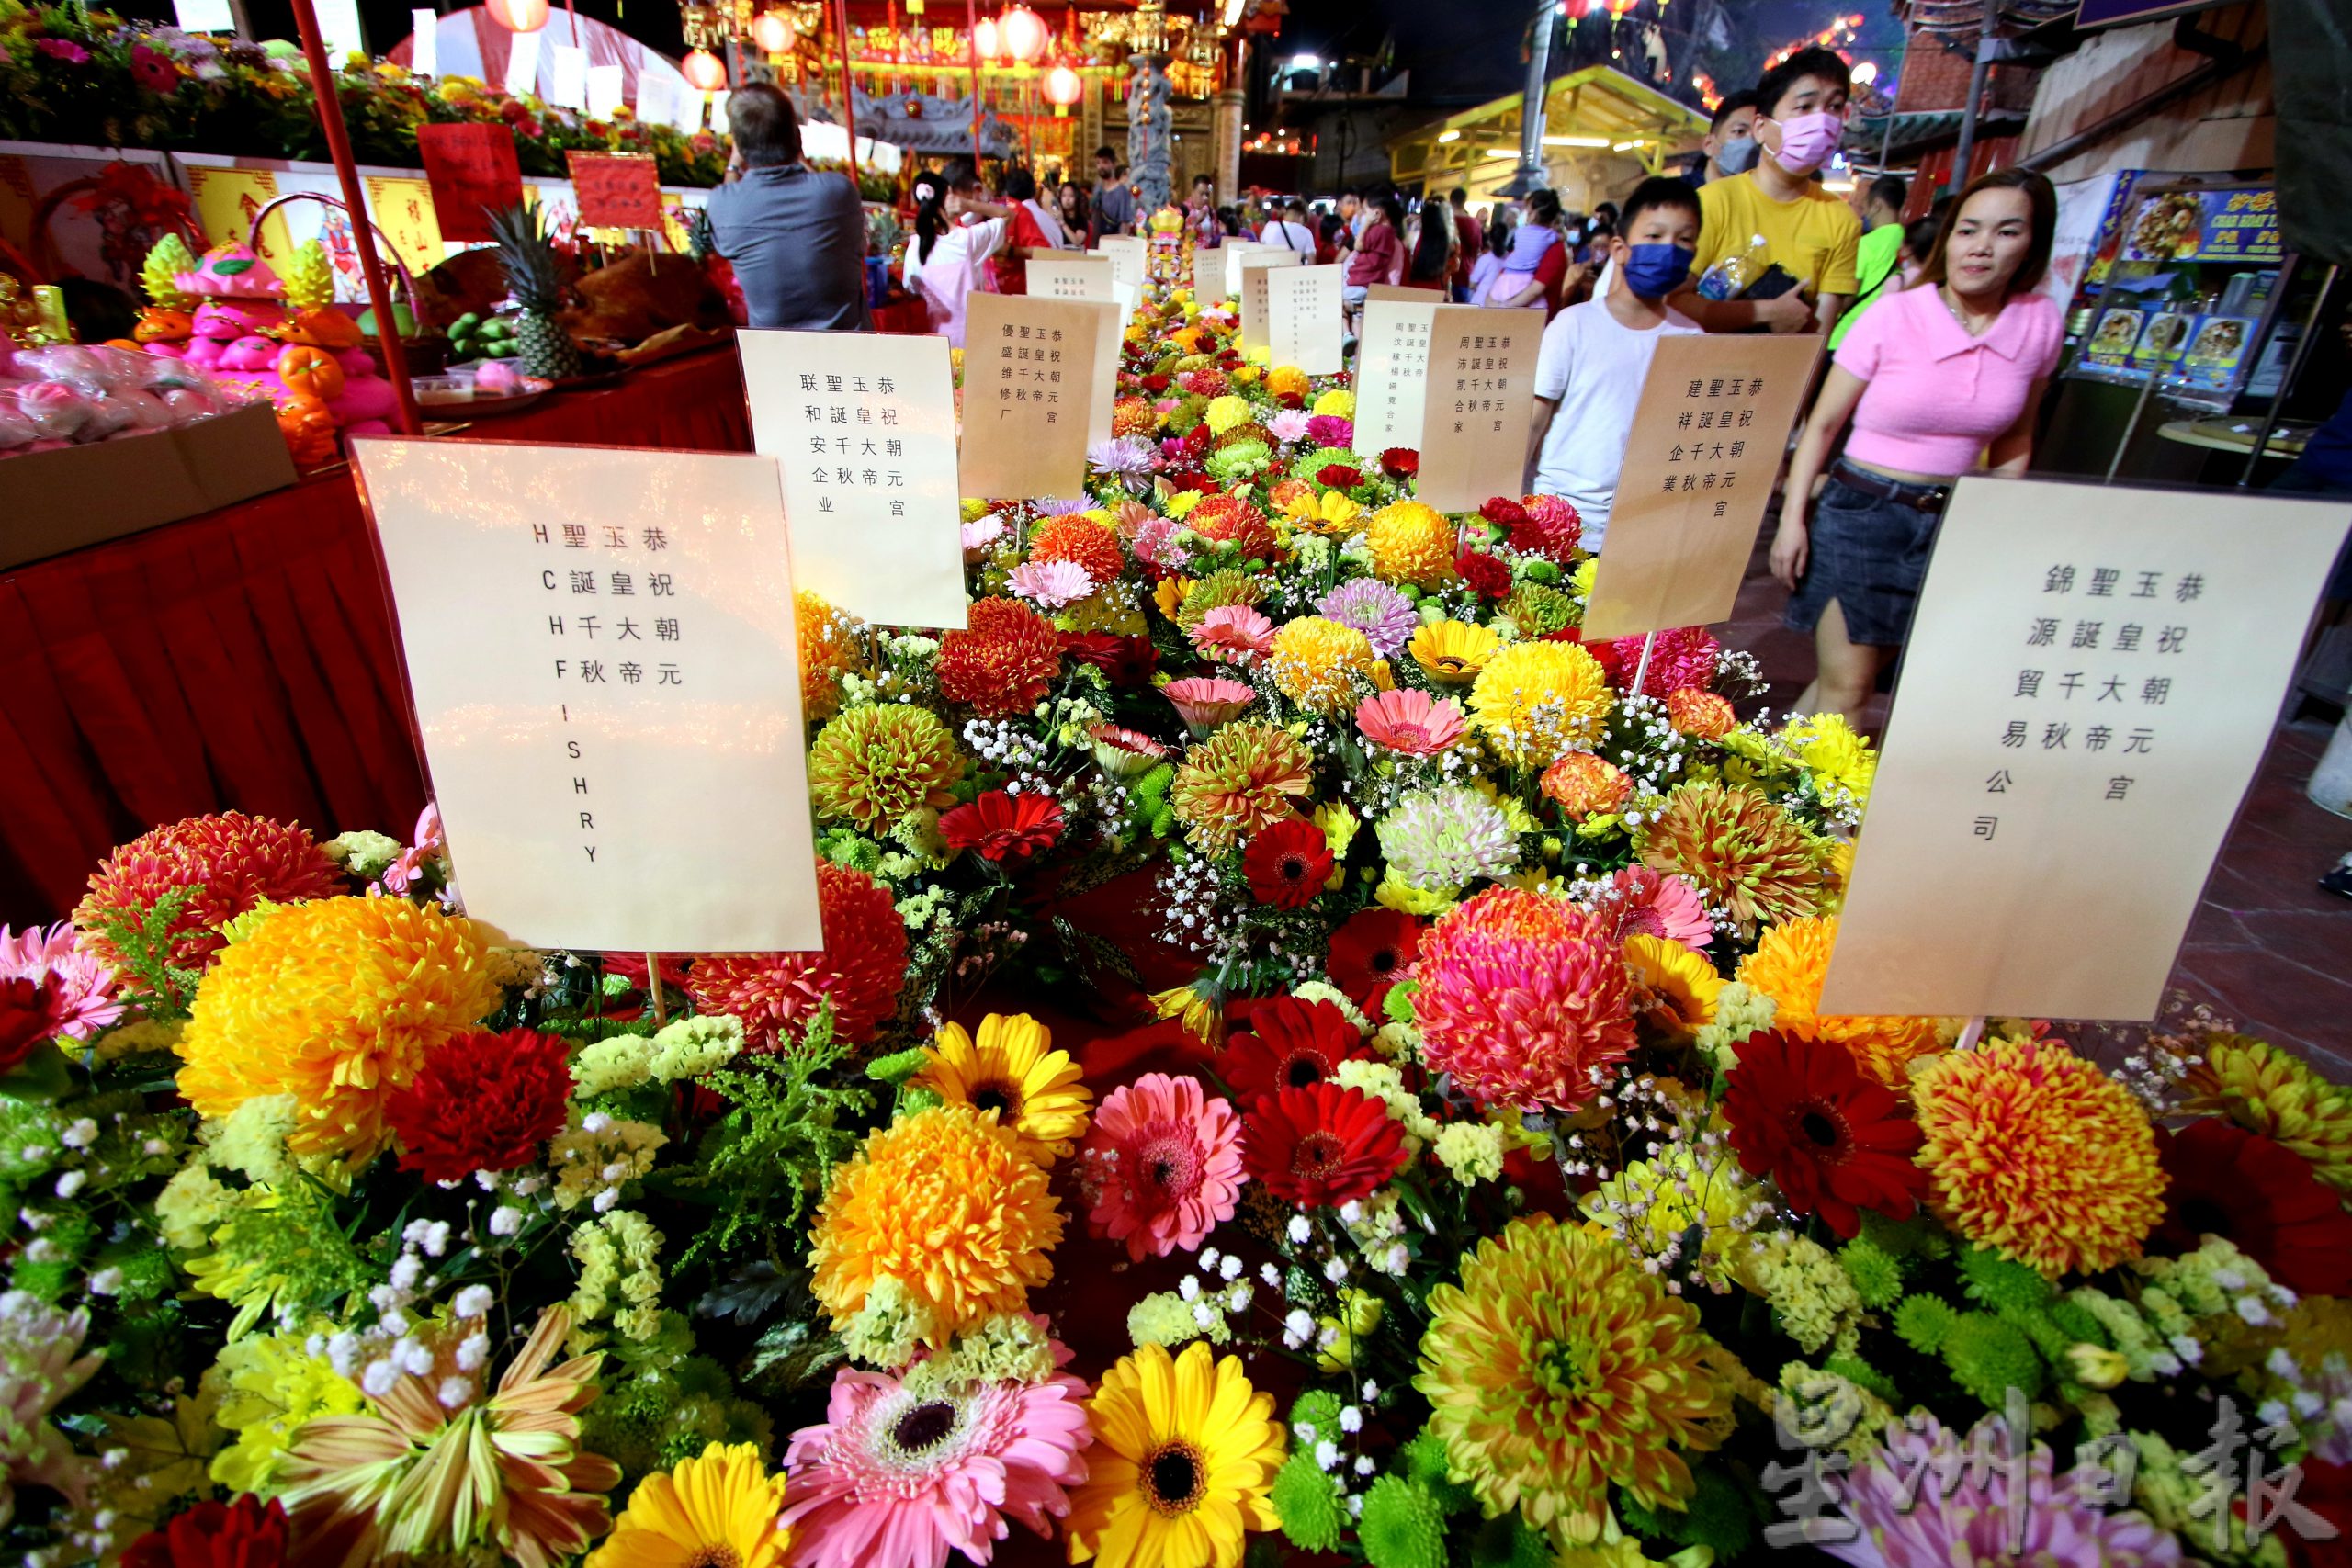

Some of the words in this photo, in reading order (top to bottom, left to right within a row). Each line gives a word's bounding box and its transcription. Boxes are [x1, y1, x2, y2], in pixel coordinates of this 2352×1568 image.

[1016, 326, 1029, 400] 聖誕千秋
[1033, 329, 1046, 401] 玉皇大帝
[1403, 323, 1416, 376] 聖誕千秋
[1415, 324, 1429, 377] 玉皇大帝
[1468, 337, 1483, 412] 聖誕千秋
[1483, 337, 1497, 411] 玉皇大帝
[800, 374, 833, 512] 联和安企业
[826, 375, 854, 484] 聖誕千秋
[853, 377, 877, 485] 玉皇大帝
[1662, 379, 1702, 492] 建祥企業
[1682, 379, 1724, 491] 聖誕千秋
[1703, 379, 1744, 490] 玉皇大帝
[561, 525, 605, 682] 聖誕千秋
[603, 526, 642, 684] 玉皇大帝
[642, 527, 682, 684] 恭祝朝元
[2041, 568, 2120, 749] 聖誕千秋
[1974, 565, 2075, 840] 錦源貿易公司
[2086, 571, 2163, 751] 玉皇大帝
